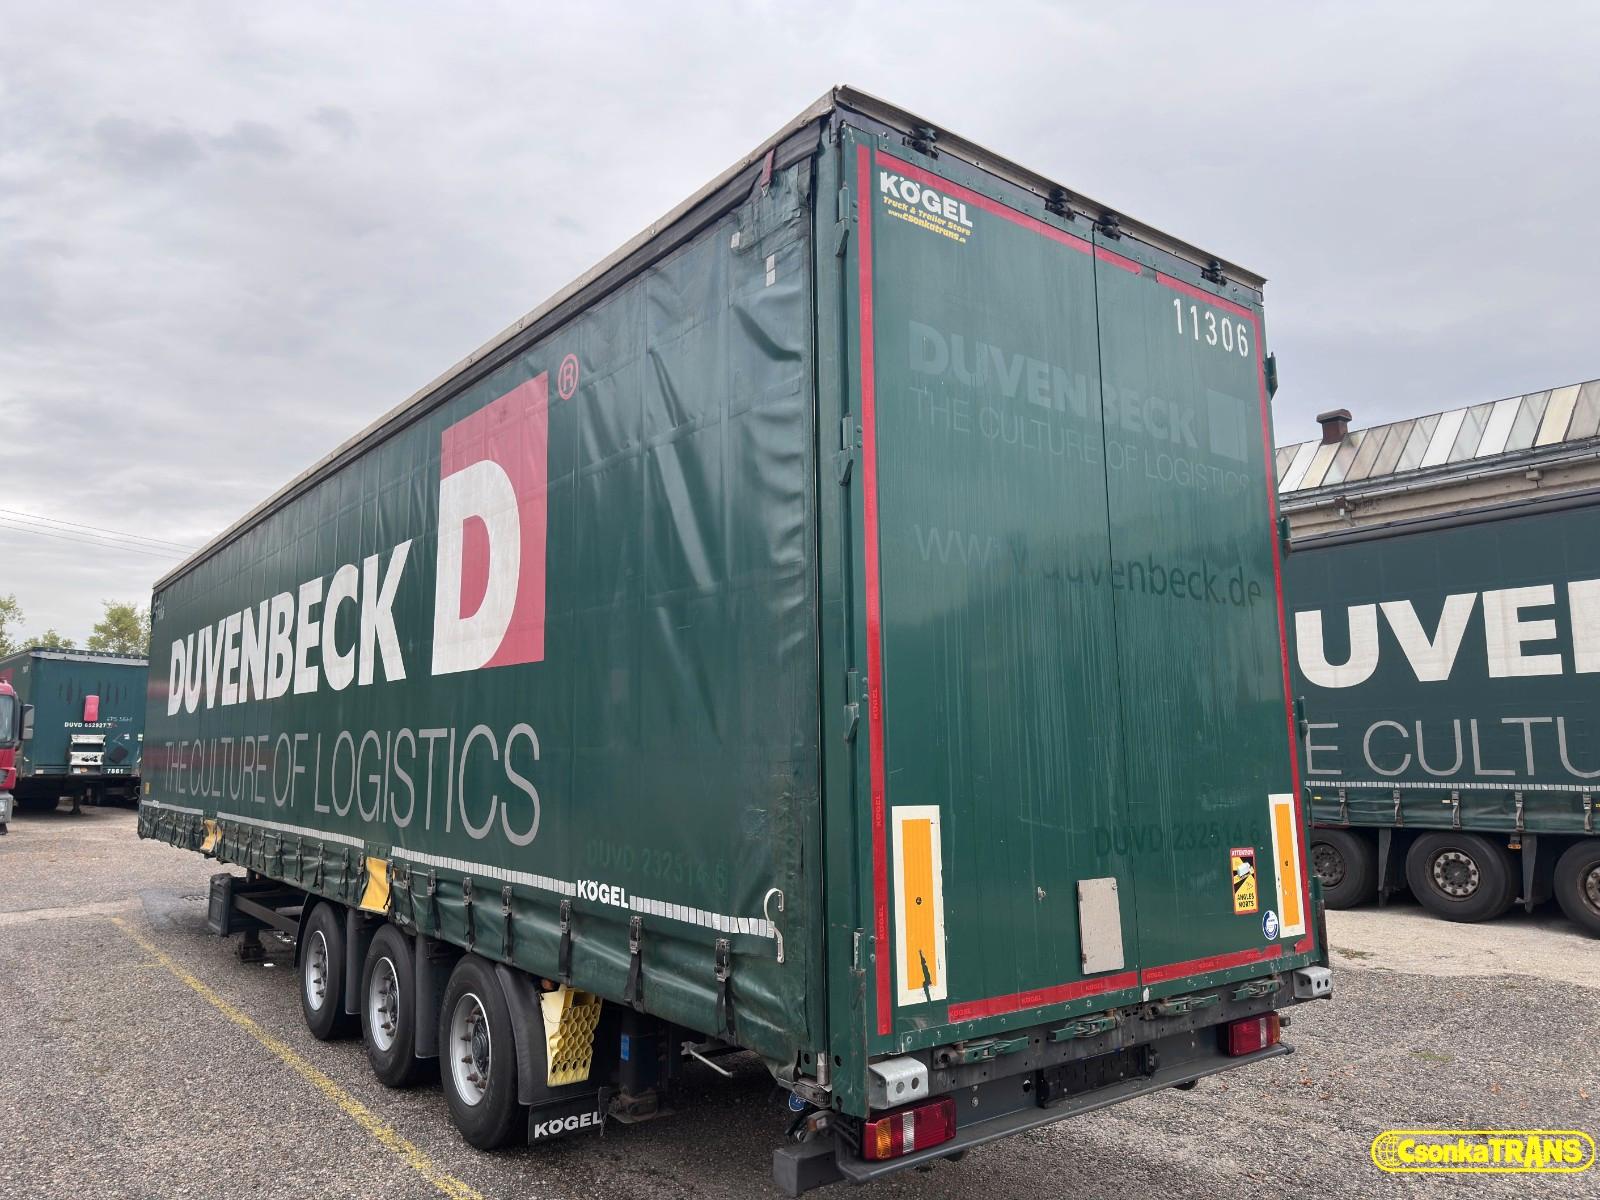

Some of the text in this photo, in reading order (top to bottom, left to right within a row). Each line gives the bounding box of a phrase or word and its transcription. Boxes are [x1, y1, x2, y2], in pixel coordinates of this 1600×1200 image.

[880, 171, 973, 228] KÖGEL
[883, 196, 971, 236] Truck & Trailer Store
[1173, 298, 1249, 357] 11306
[908, 319, 1199, 449] DUVENBECK
[909, 386, 1250, 493] THE CULTURE OF LOGISTICS
[167, 459, 521, 717] DUVENBECK D
[1363, 716, 1600, 778] CULTU
[165, 722, 541, 847] THE CULTURE OF LOGISTICS
[577, 879, 629, 909] KÖGEL
[1237, 892, 1255, 901] ANGLES
[534, 1111, 602, 1139] KÖGEL
